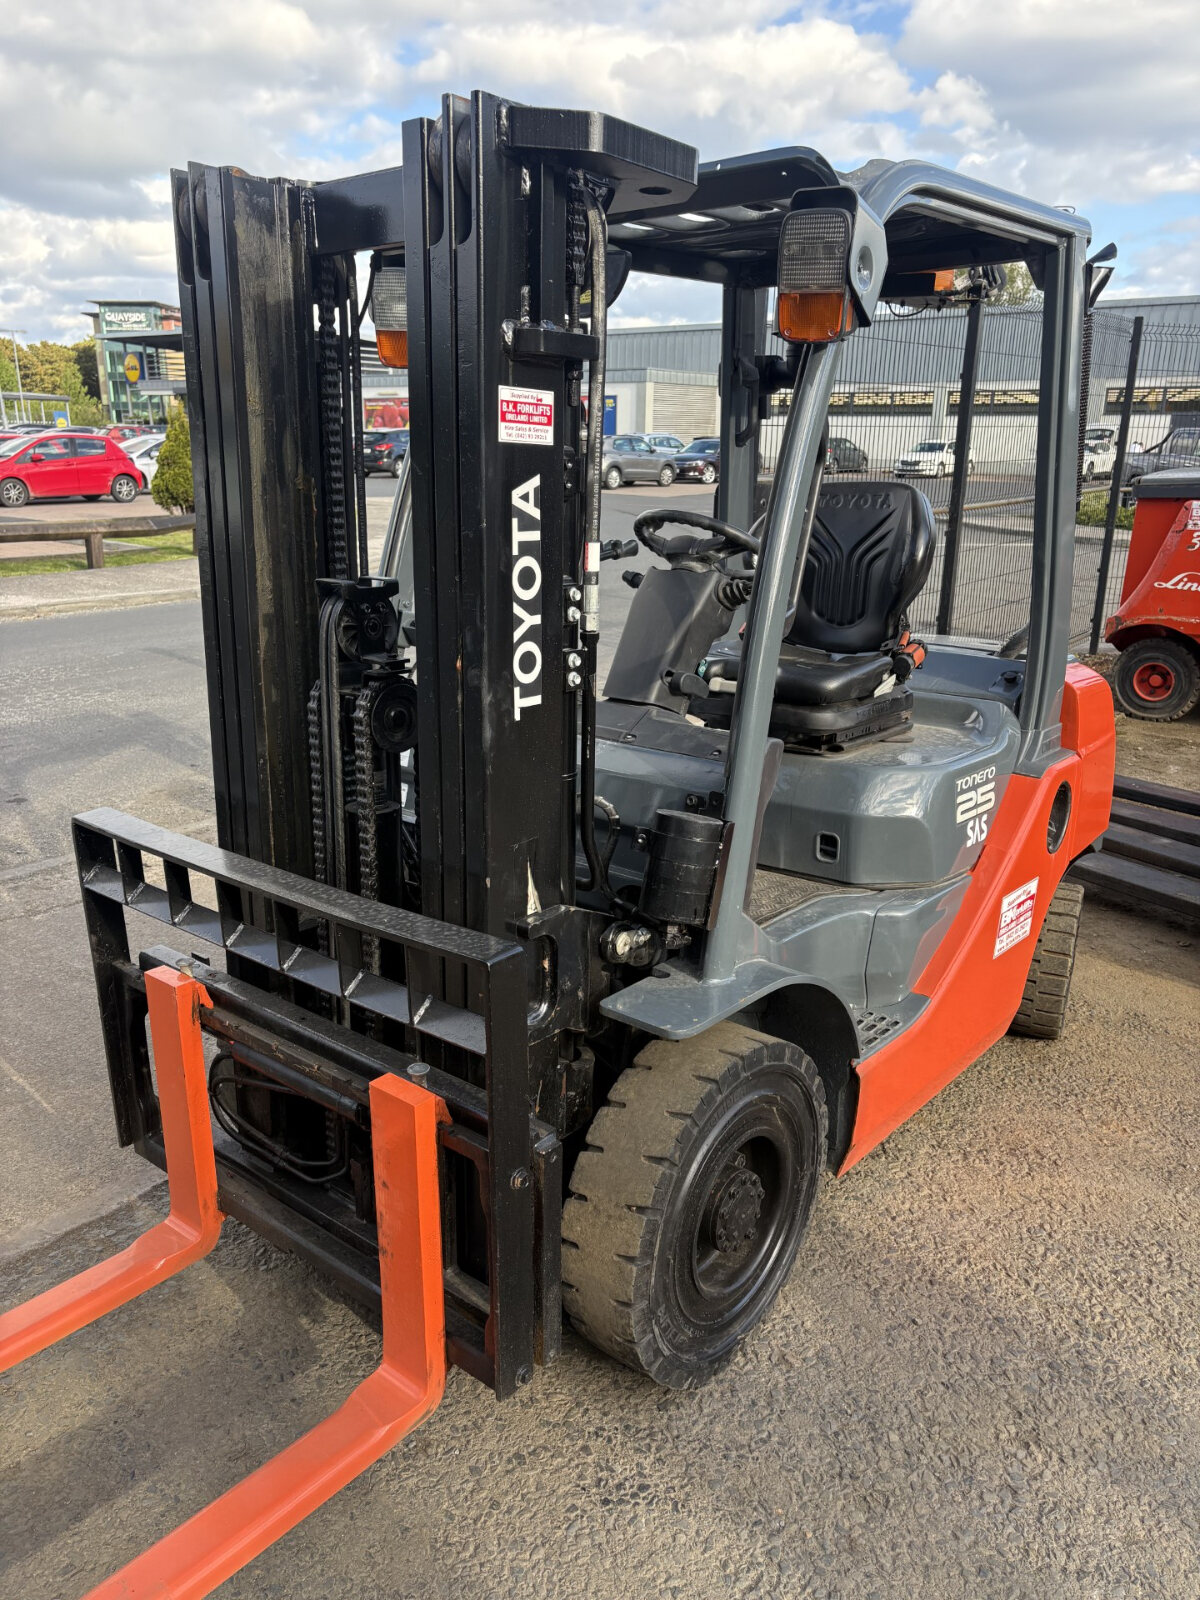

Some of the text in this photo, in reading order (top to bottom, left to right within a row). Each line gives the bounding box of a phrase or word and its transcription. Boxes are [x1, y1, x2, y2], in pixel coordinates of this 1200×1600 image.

[105, 312, 147, 321] QUAYSIDE
[502, 402, 550, 416] B.K. FORKLIFTS
[506, 412, 528, 422] (IRELAND)
[818, 492, 894, 510] TOYOTA
[1153, 571, 1200, 592] Lin
[511, 473, 542, 722] TOYOTA
[956, 781, 995, 824] 25
[966, 813, 988, 848] SAS
